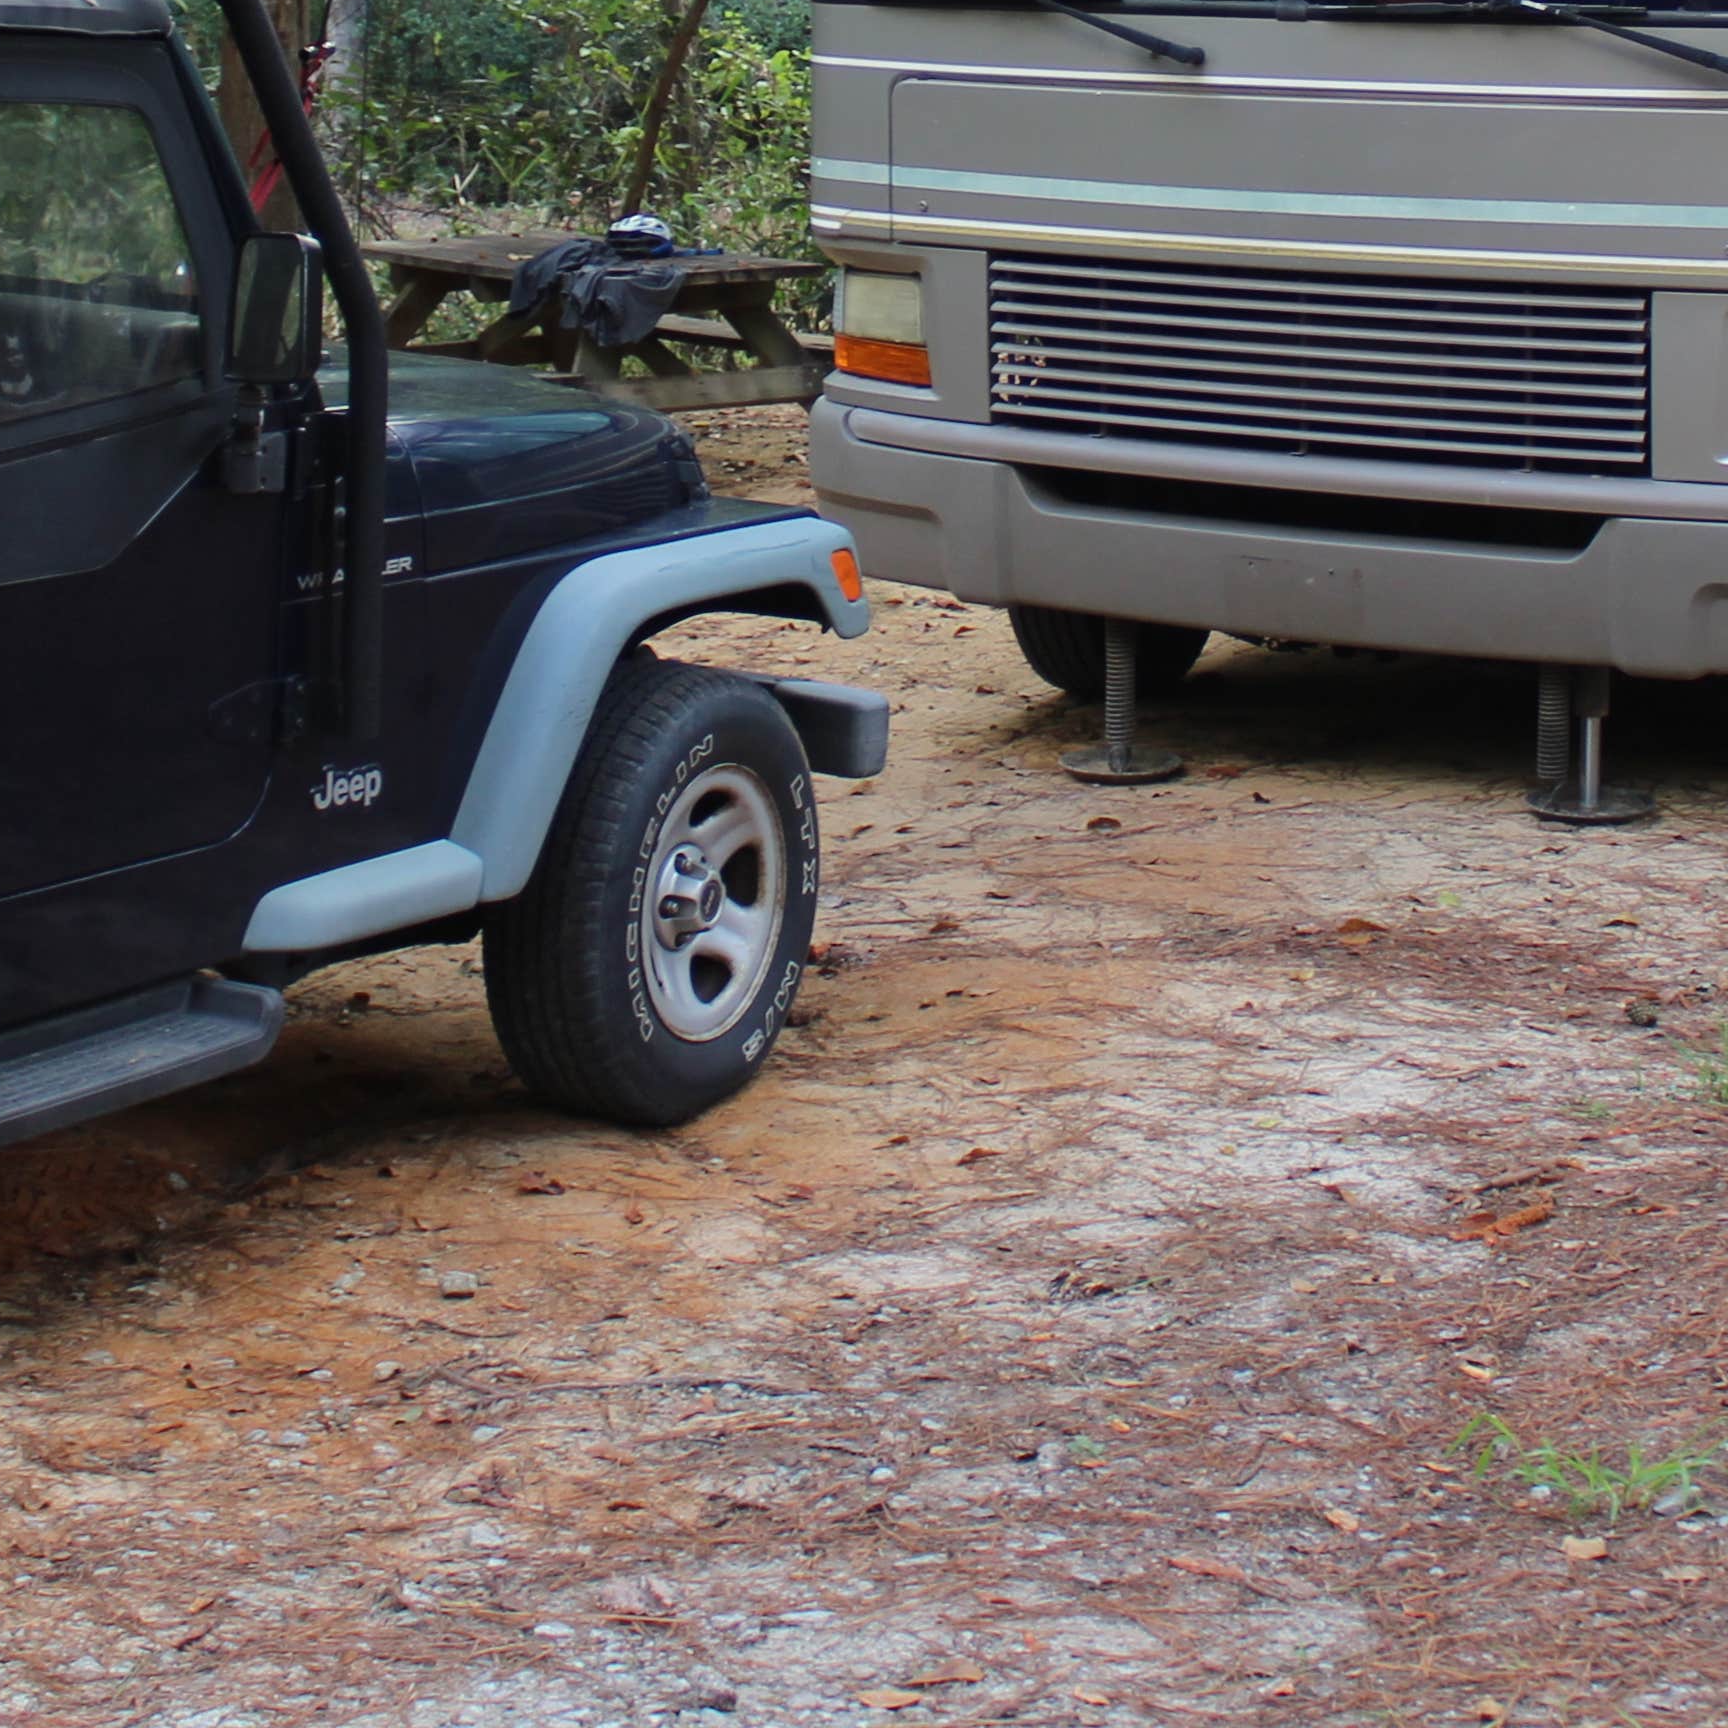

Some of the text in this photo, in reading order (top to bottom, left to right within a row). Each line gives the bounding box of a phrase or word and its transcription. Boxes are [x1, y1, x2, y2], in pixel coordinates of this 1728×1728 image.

[313, 768, 383, 811] Jeep
[790, 775, 816, 895] LTX
[626, 734, 714, 1041] MICHELIN
